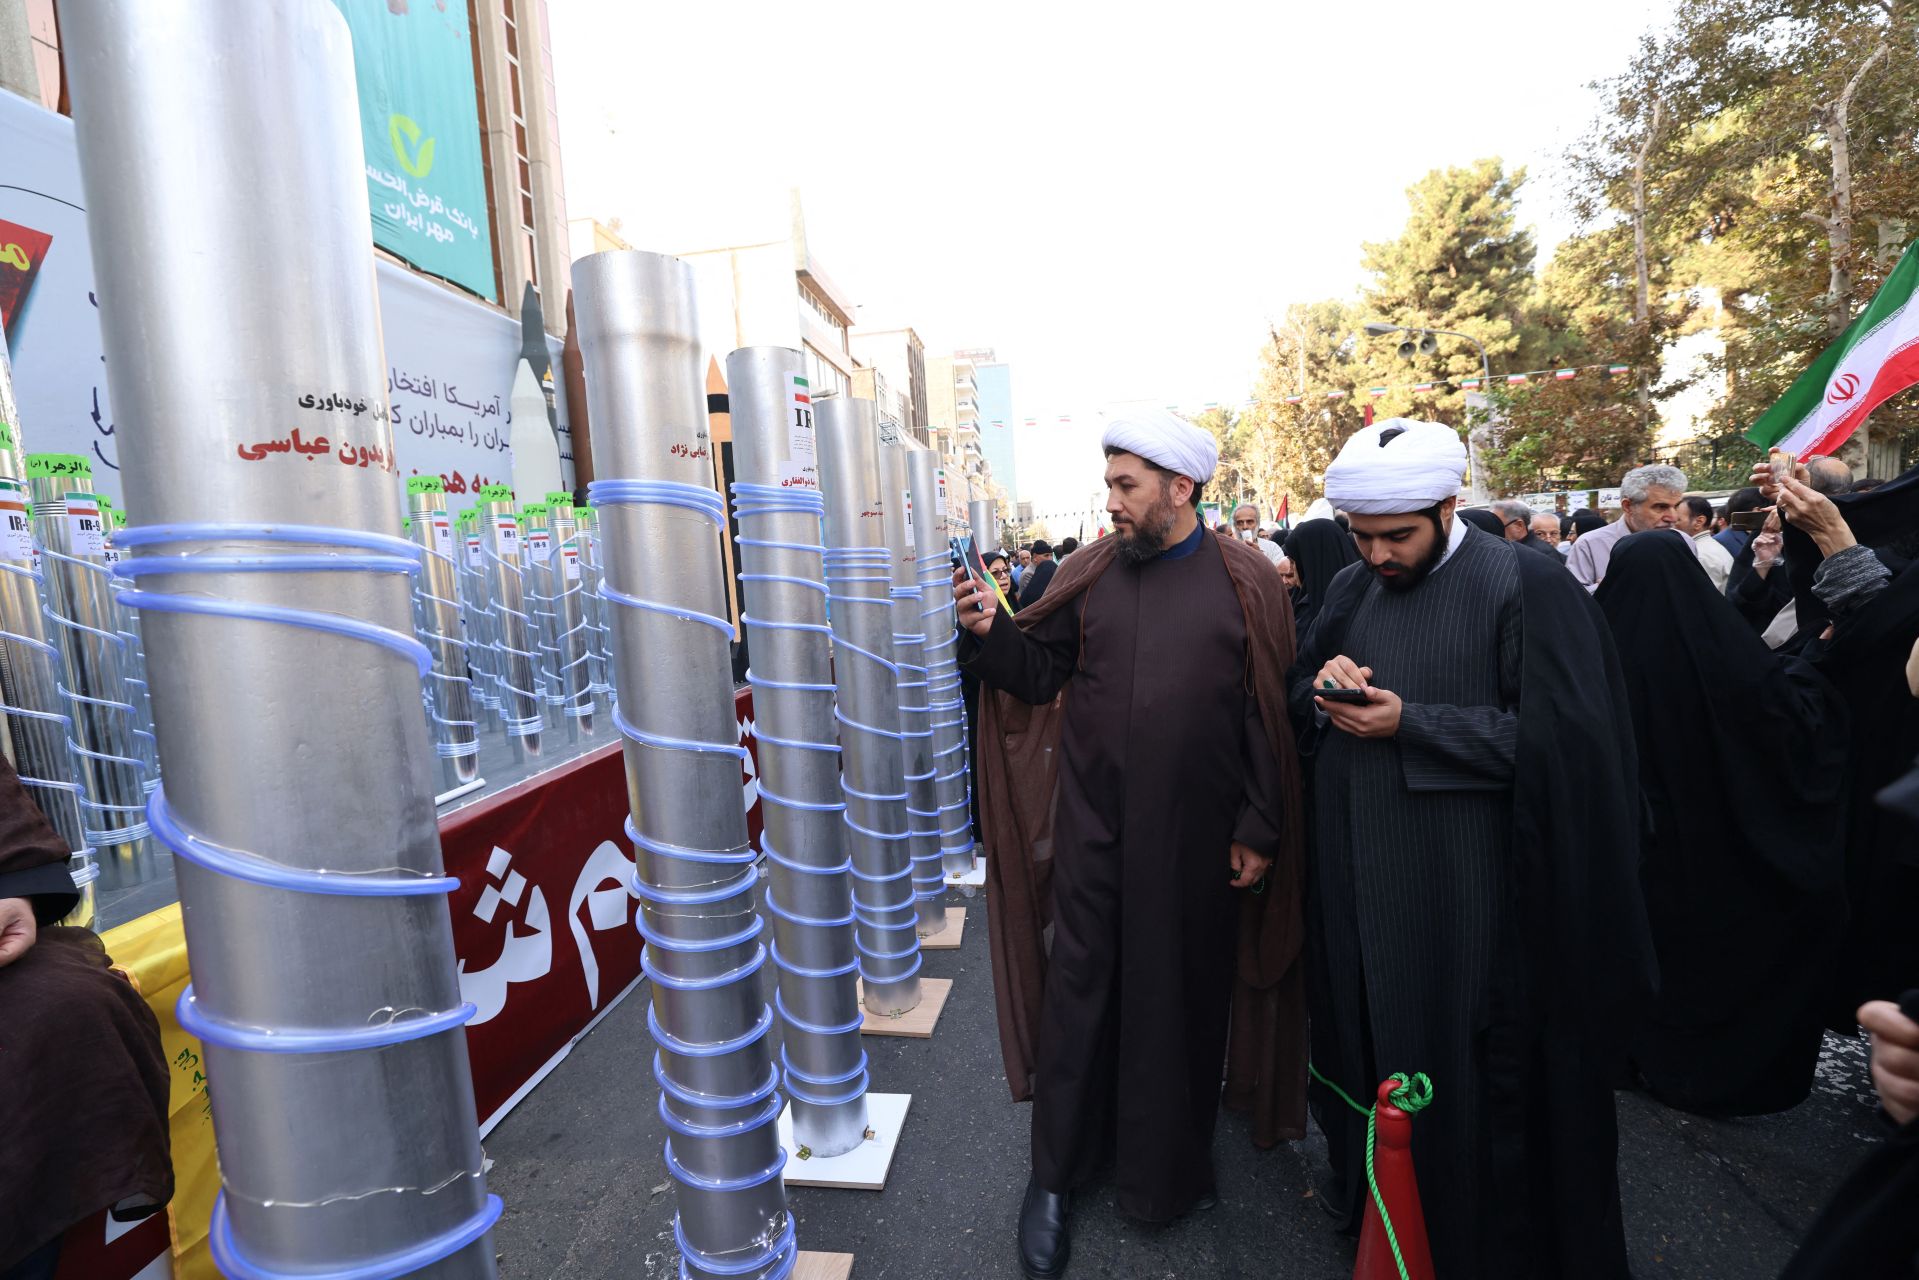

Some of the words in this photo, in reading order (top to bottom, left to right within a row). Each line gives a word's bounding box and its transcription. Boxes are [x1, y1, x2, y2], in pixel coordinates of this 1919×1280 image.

[366, 165, 408, 196] الحس
[408, 188, 444, 214] قرض
[384, 203, 424, 232] ایران
[446, 207, 478, 239] بانک
[425, 221, 454, 242] مهر
[387, 367, 437, 400] افتخار
[298, 393, 367, 416] خودباوری
[409, 410, 464, 444] بمباران
[469, 421, 479, 447] را
[484, 428, 510, 453] ران
[237, 428, 331, 462] عباسی
[338, 441, 394, 473] ریدون
[79, 518, 101, 532] IR-9
[104, 551, 119, 562] R-9
